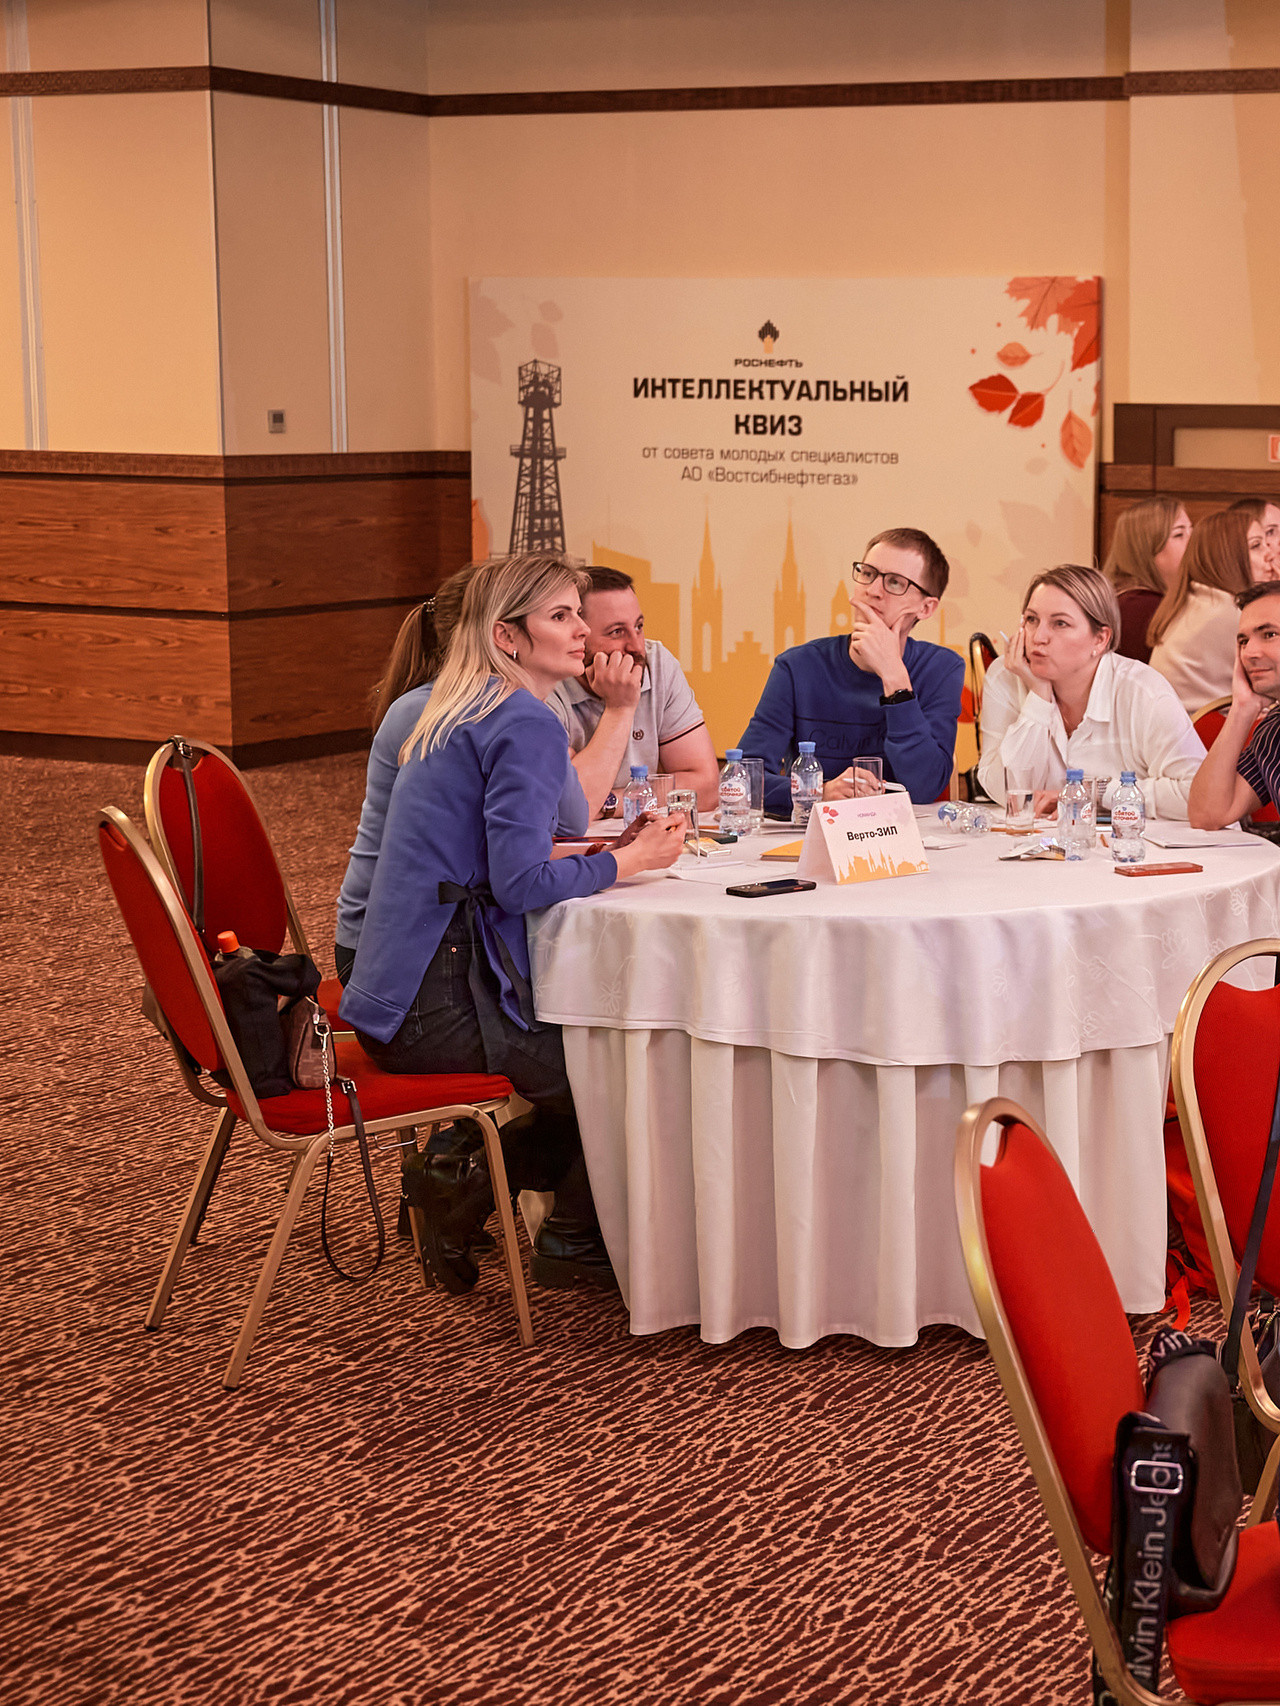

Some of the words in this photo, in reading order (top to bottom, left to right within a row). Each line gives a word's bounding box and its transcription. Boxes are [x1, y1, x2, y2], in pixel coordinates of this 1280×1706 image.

[734, 358, 803, 368] РОСНЕФТЬ
[633, 375, 909, 403] ИНТЕЛЛЕКТУАЛЬНЫЙ
[734, 414, 803, 436] КВИЗ
[642, 447, 658, 459] от
[664, 447, 714, 460] совета
[720, 449, 785, 464] молодых
[790, 450, 899, 465] специалистов
[681, 466, 703, 482] АО
[708, 466, 859, 488] «Востсибнефтегаз»
[1131, 1531, 1166, 1610] Klein
[1126, 1618, 1158, 1679] lvin
